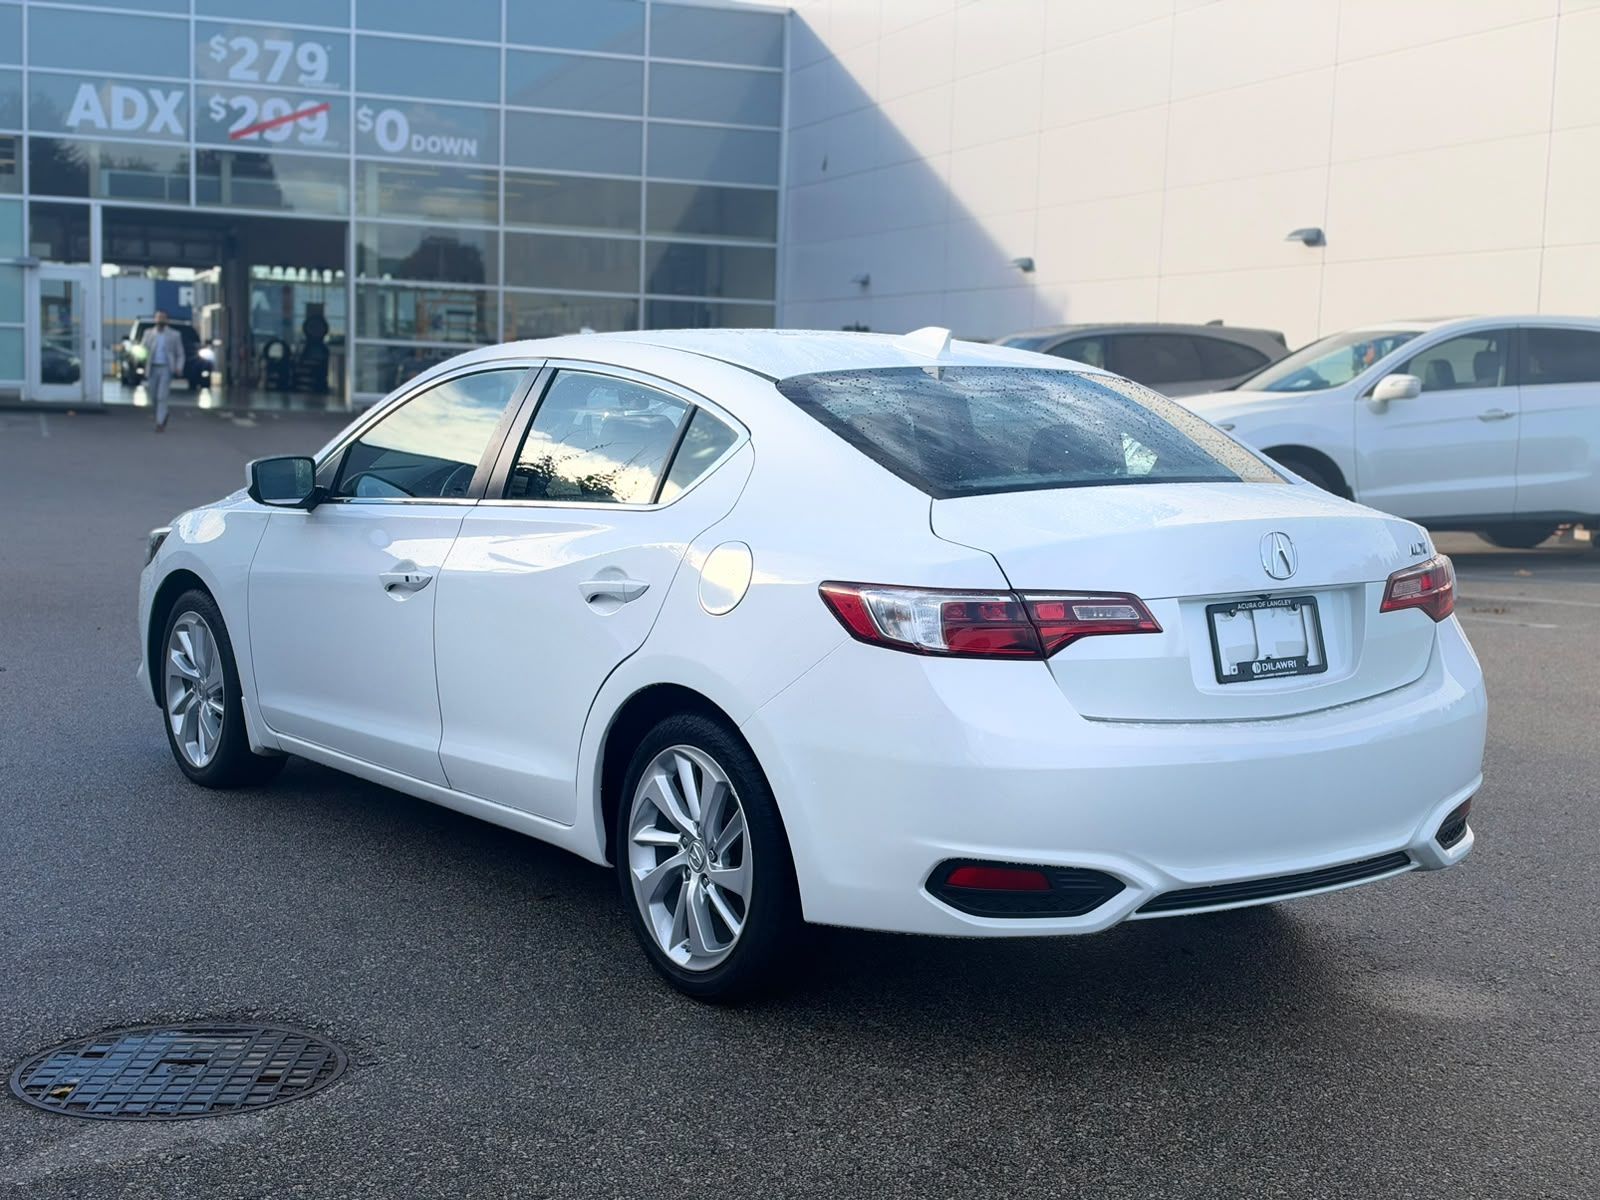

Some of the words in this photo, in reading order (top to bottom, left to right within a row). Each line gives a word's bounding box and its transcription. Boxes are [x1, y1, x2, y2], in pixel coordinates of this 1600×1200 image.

[65, 83, 184, 135] ADX
[209, 93, 331, 145] $299
[357, 104, 410, 153] $0
[411, 134, 478, 157] DOWN
[1237, 602, 1257, 610] ACURA
[1257, 600, 1266, 608] OF
[1266, 599, 1292, 607] LANGLEY
[1261, 659, 1297, 672] DILAWRI
